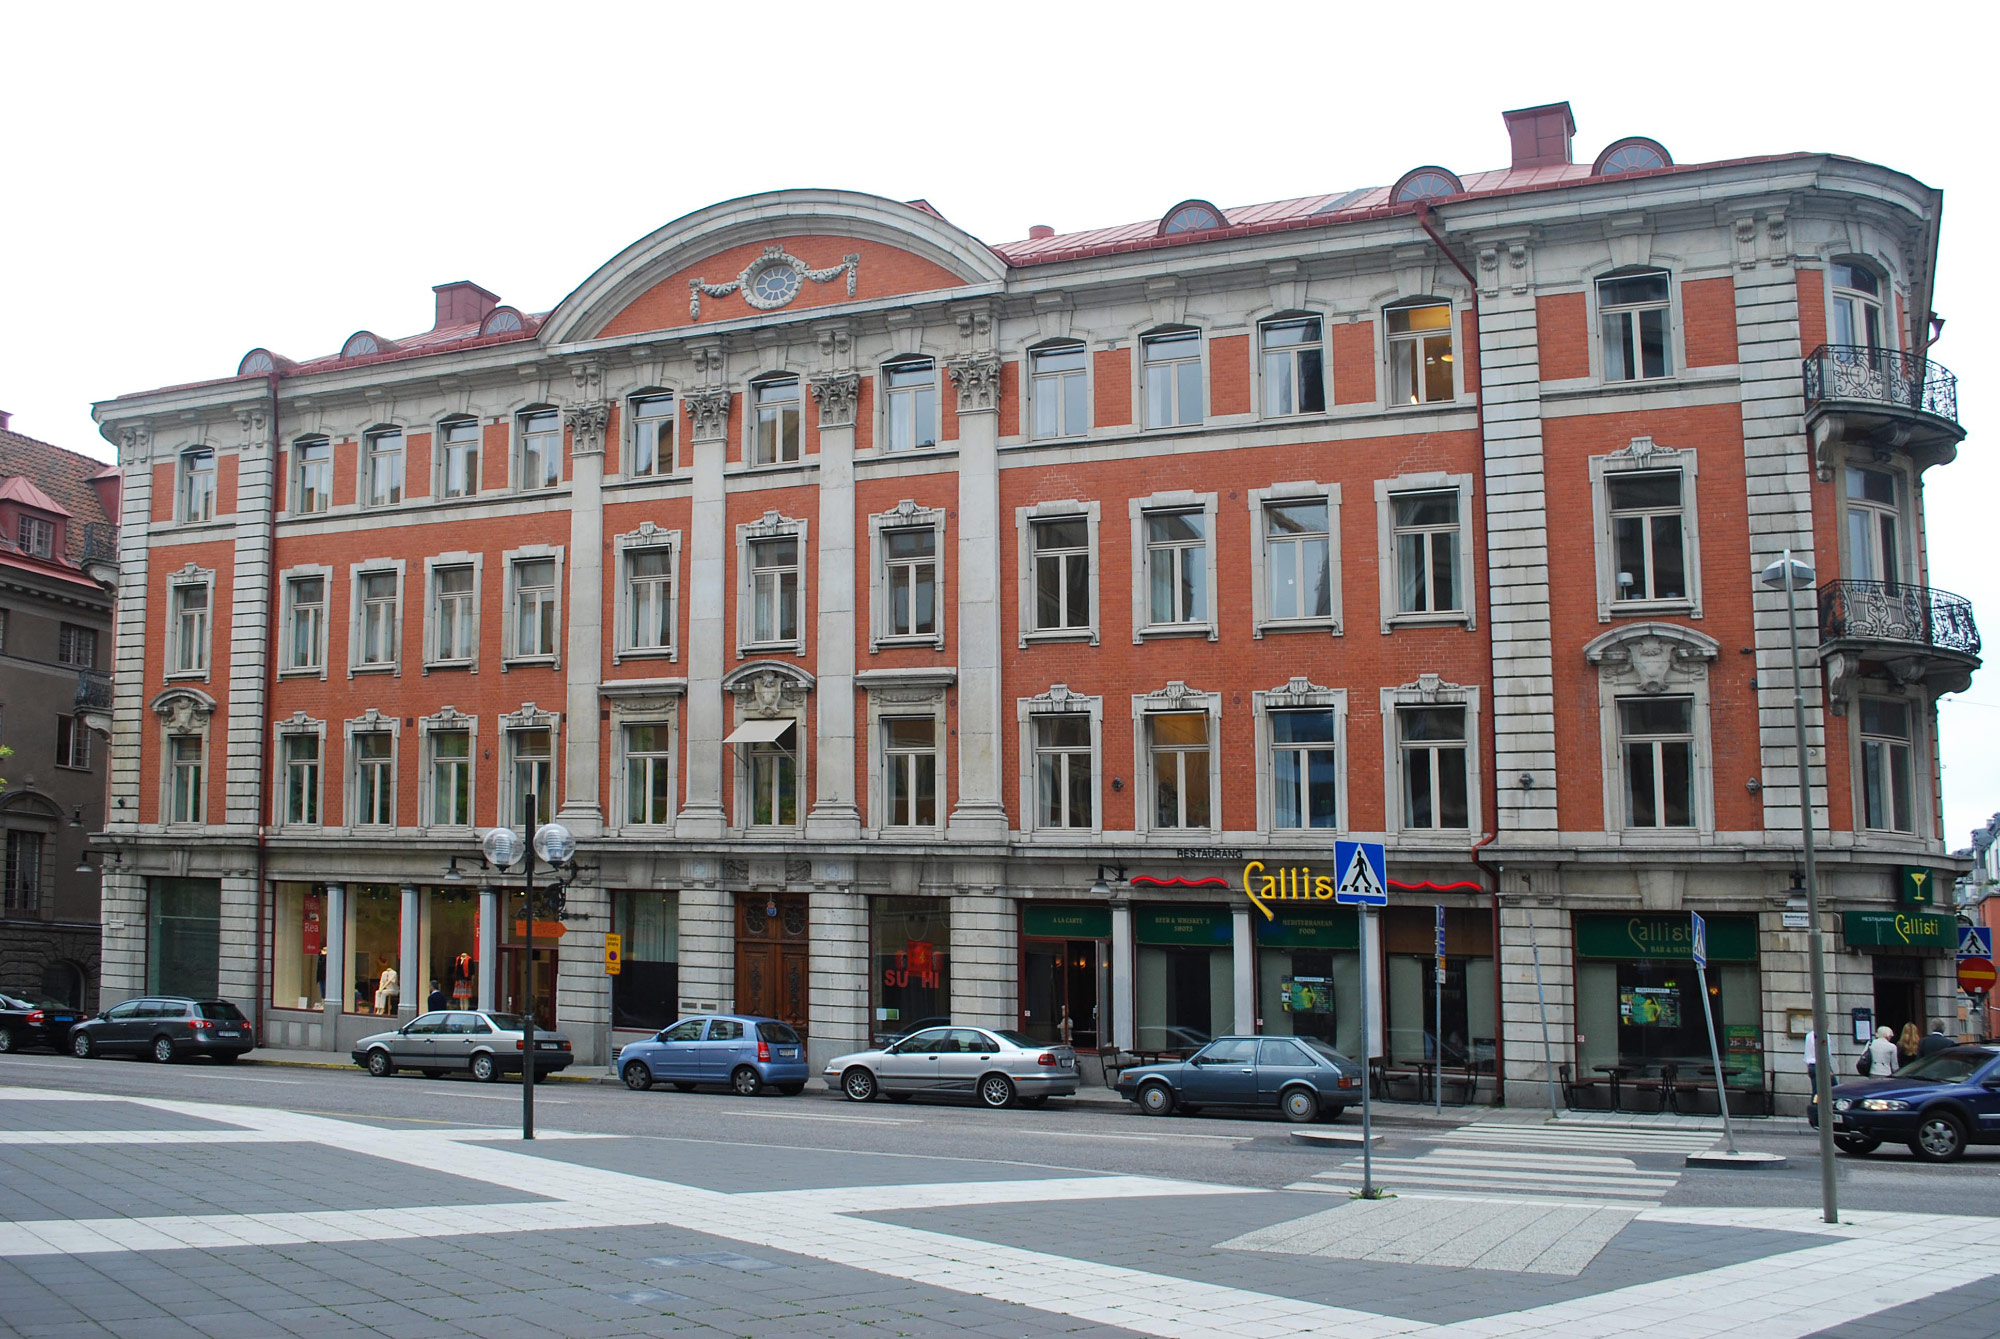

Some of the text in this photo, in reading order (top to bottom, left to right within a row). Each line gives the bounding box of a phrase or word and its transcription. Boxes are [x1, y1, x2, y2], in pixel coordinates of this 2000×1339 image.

[1177, 849, 1243, 859] RESTAURANG
[1243, 860, 1334, 922] Callis
[304, 923, 319, 933] Rea
[1628, 918, 1692, 953] Callist
[1895, 914, 1939, 944] Callisti
[884, 969, 940, 989] SUHI
